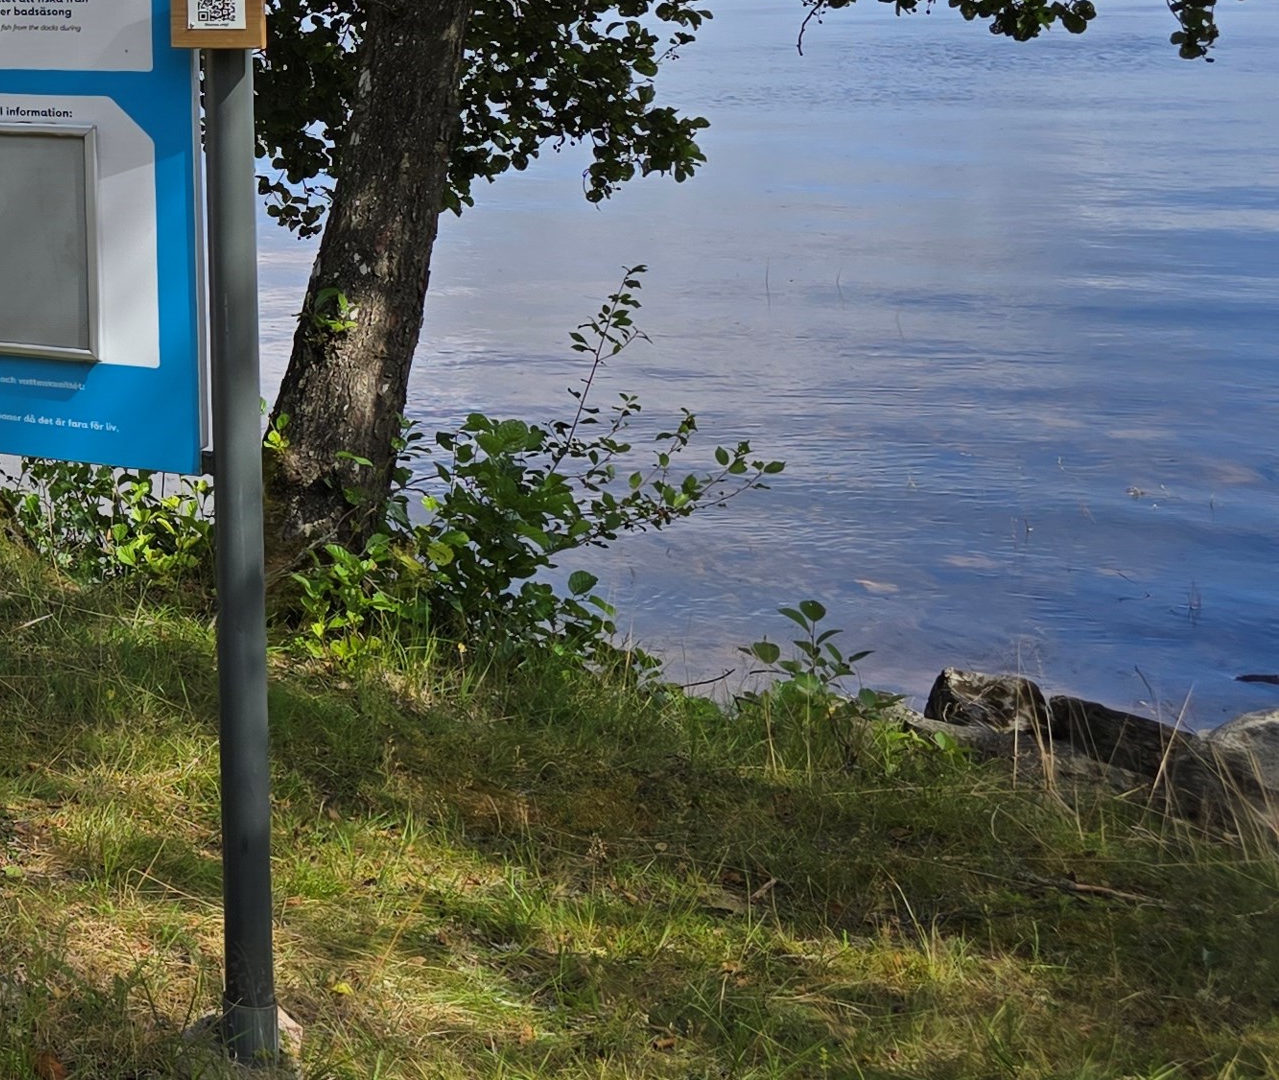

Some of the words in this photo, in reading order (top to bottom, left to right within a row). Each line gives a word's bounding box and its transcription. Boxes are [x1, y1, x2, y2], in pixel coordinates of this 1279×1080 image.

[14, 7, 72, 18] badsäsong
[6, 107, 73, 117] information:
[24, 414, 35, 423] då
[38, 415, 53, 425] det
[56, 417, 65, 426] är
[68, 419, 88, 429] fara
[91, 420, 103, 430] för
[106, 422, 119, 432] liv.
